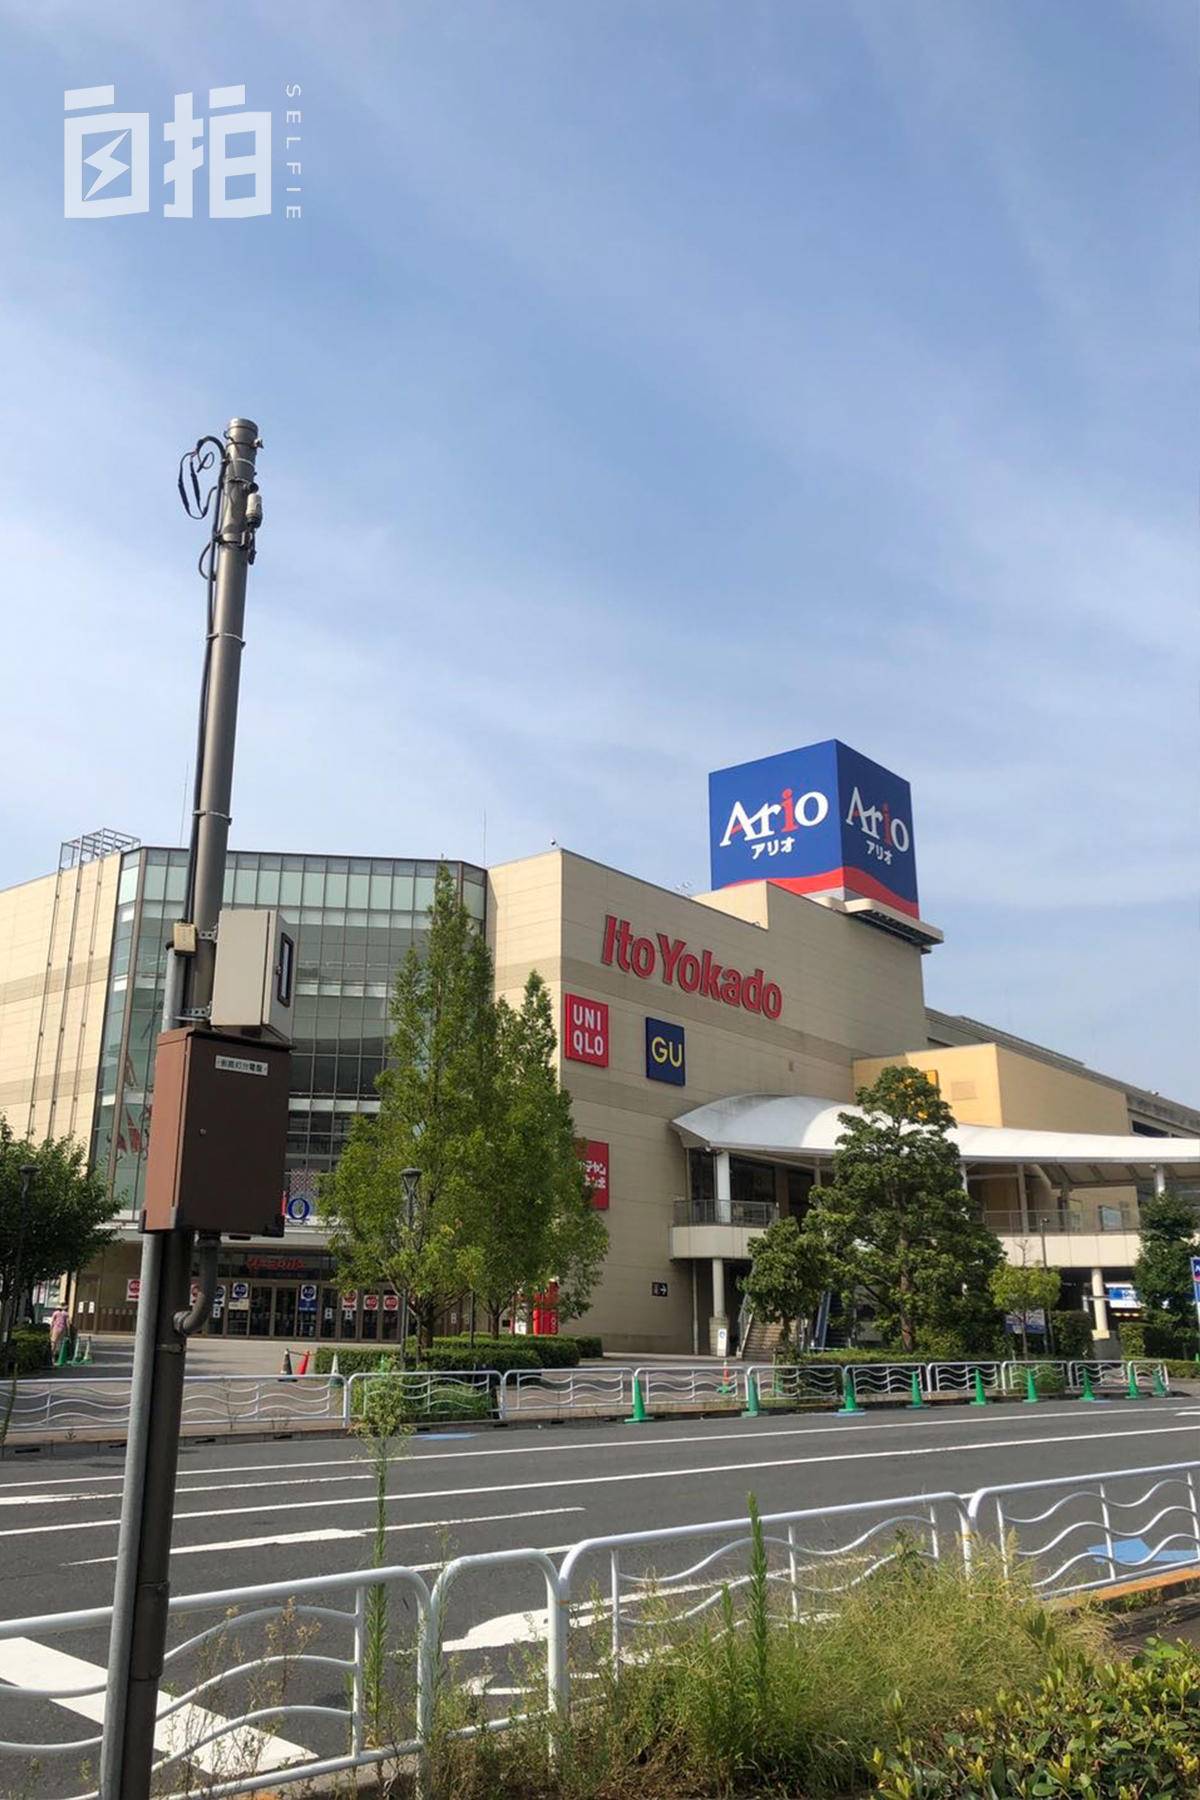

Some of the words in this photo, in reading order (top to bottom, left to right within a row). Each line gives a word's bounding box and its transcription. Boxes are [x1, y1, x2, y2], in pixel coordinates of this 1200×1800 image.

[719, 788, 829, 847] Ario
[846, 786, 910, 852] Ario
[751, 836, 796, 860] アリオ
[866, 840, 893, 865] アリオ
[572, 1003, 601, 1031] UNI
[572, 1030, 604, 1056] QLO
[652, 1036, 683, 1068] GU
